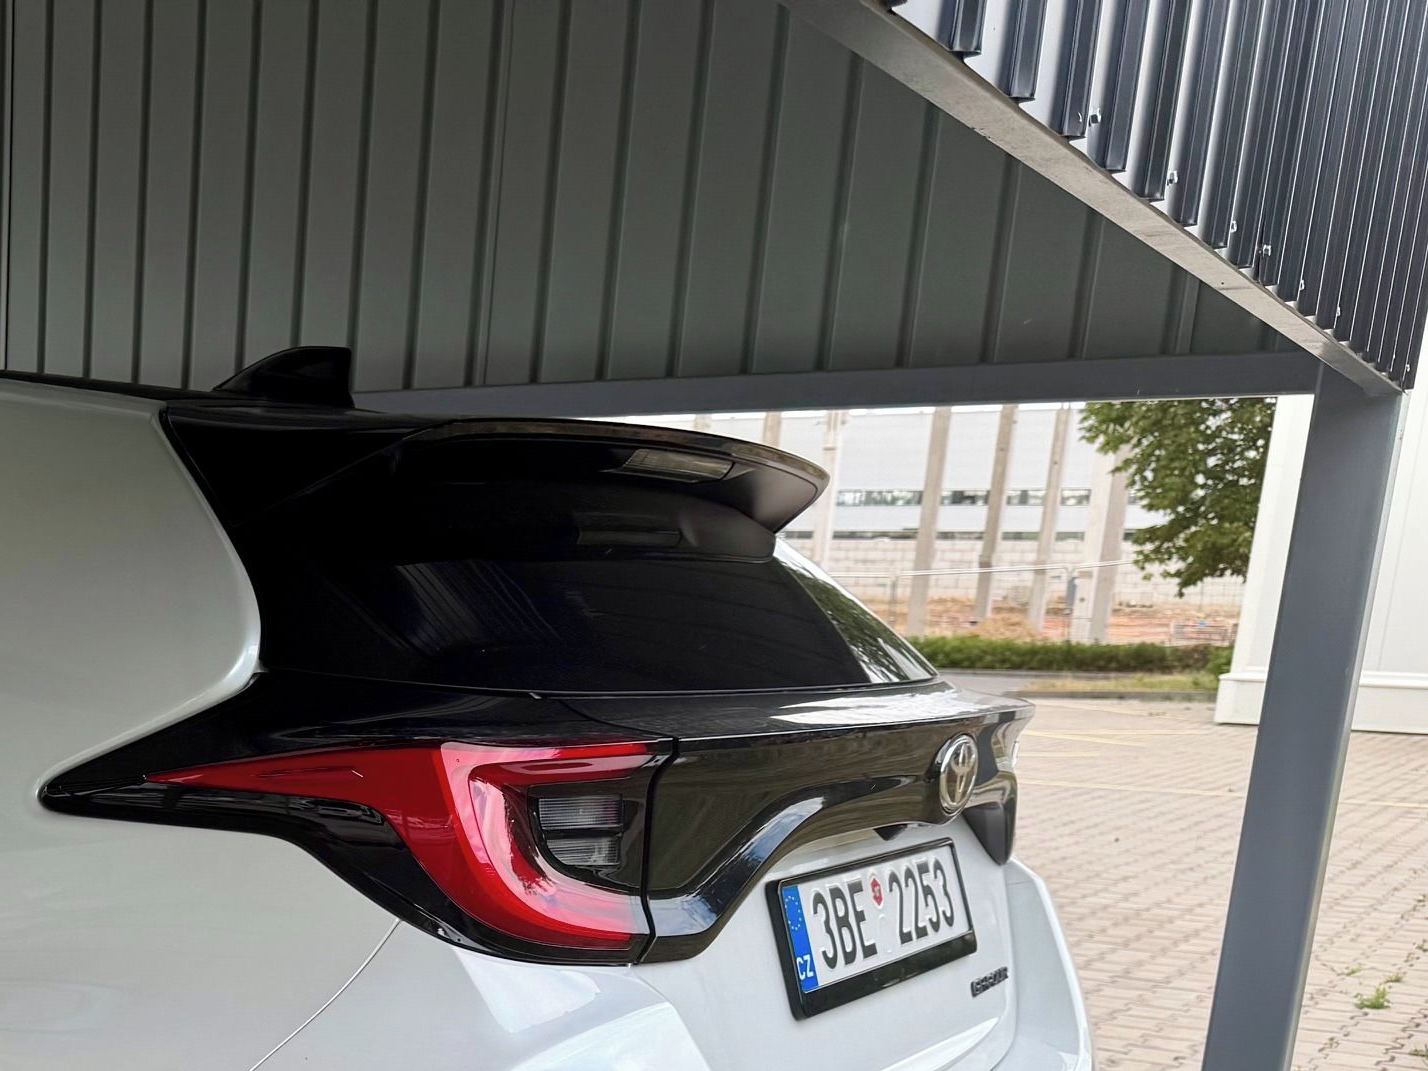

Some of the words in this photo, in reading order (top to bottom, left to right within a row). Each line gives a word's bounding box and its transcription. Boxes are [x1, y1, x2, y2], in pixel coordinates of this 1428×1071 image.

[812, 879, 876, 970] 3BE
[888, 857, 954, 945] 2253
[797, 954, 814, 980] CZ
